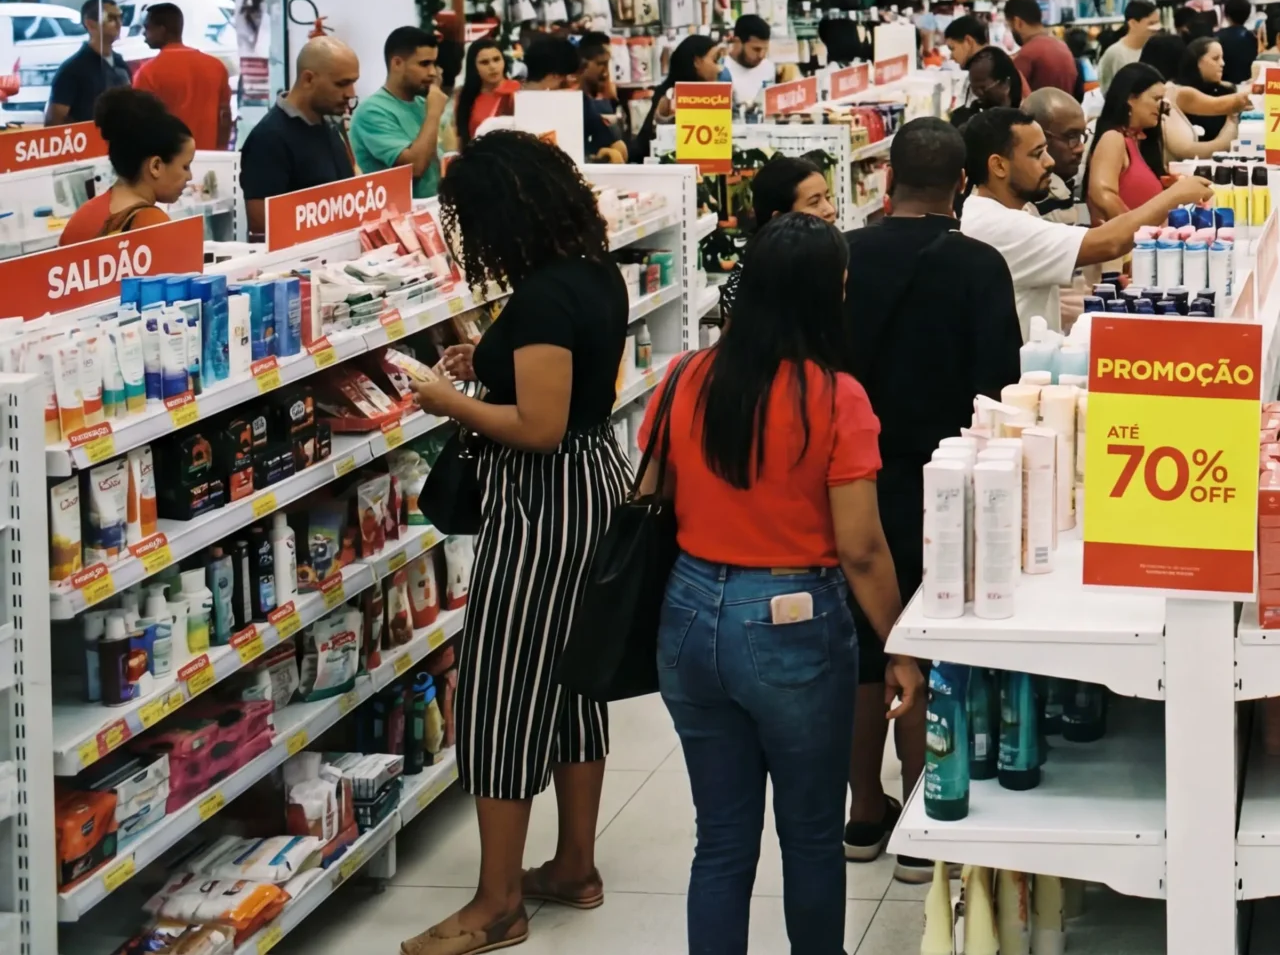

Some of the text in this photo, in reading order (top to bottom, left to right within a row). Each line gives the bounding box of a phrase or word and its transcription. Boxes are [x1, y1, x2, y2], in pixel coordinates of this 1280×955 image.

[15, 128, 87, 162] SALDÃO
[296, 181, 387, 231] PROMOÇÃO
[48, 240, 152, 299] SALDÃO
[1097, 358, 1254, 387] PROMOÇÃO
[1107, 424, 1139, 439] ATÉ
[1107, 444, 1228, 501] 70%
[1190, 486, 1236, 503] OFF
